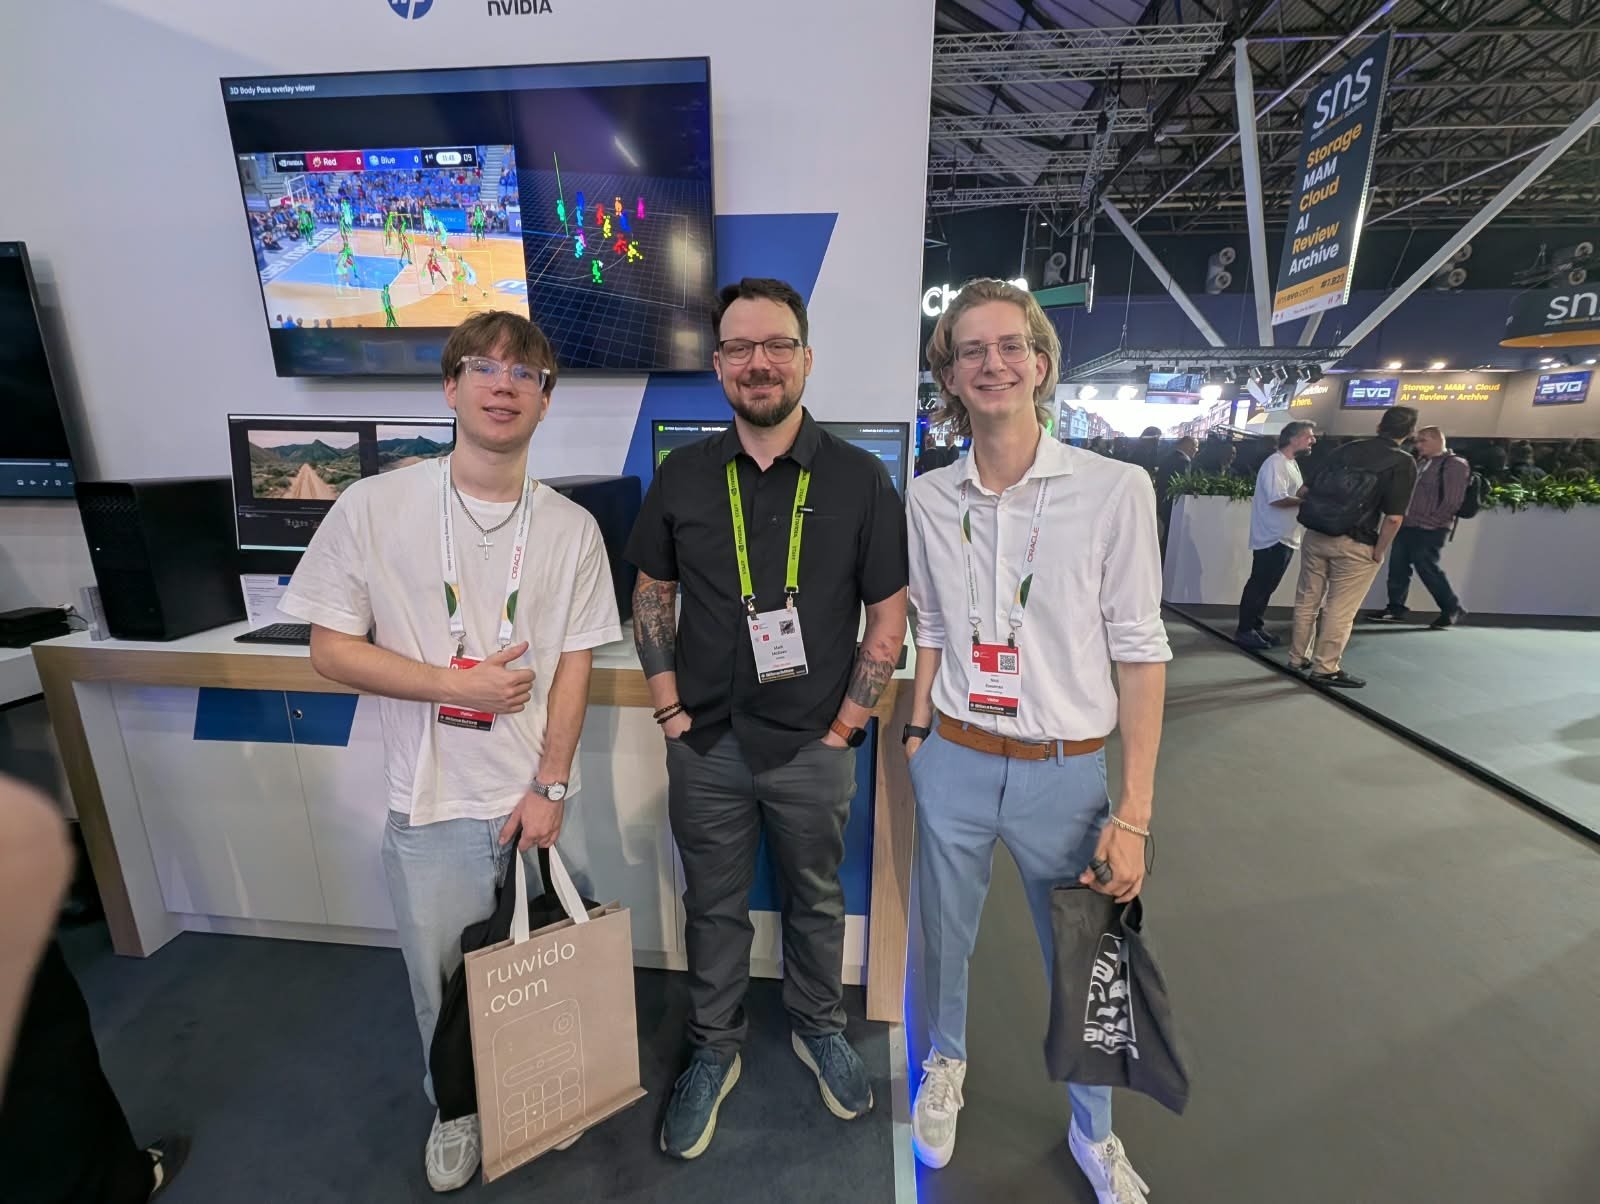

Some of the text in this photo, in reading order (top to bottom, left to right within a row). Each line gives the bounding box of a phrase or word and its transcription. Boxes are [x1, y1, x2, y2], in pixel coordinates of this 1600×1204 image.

[240, 86, 256, 96] Body
[1312, 57, 1374, 130] sns
[323, 157, 337, 166] Red
[380, 156, 396, 165] Blue
[1306, 123, 1362, 168] Storage
[1302, 155, 1338, 191] MAM
[1299, 175, 1340, 212] Cloud
[1291, 221, 1341, 255] Review
[1295, 212, 1310, 235] AI
[1288, 242, 1340, 277] Archive
[1546, 292, 1600, 320] sn
[1400, 392, 1489, 401] AI Review Archive
[1402, 383, 1501, 392] Storage MAM Cloud
[1027, 527, 1040, 562] ORACLE
[511, 546, 522, 580] ORACLE
[486, 941, 576, 988] ruwido
[484, 977, 548, 1017] .com
